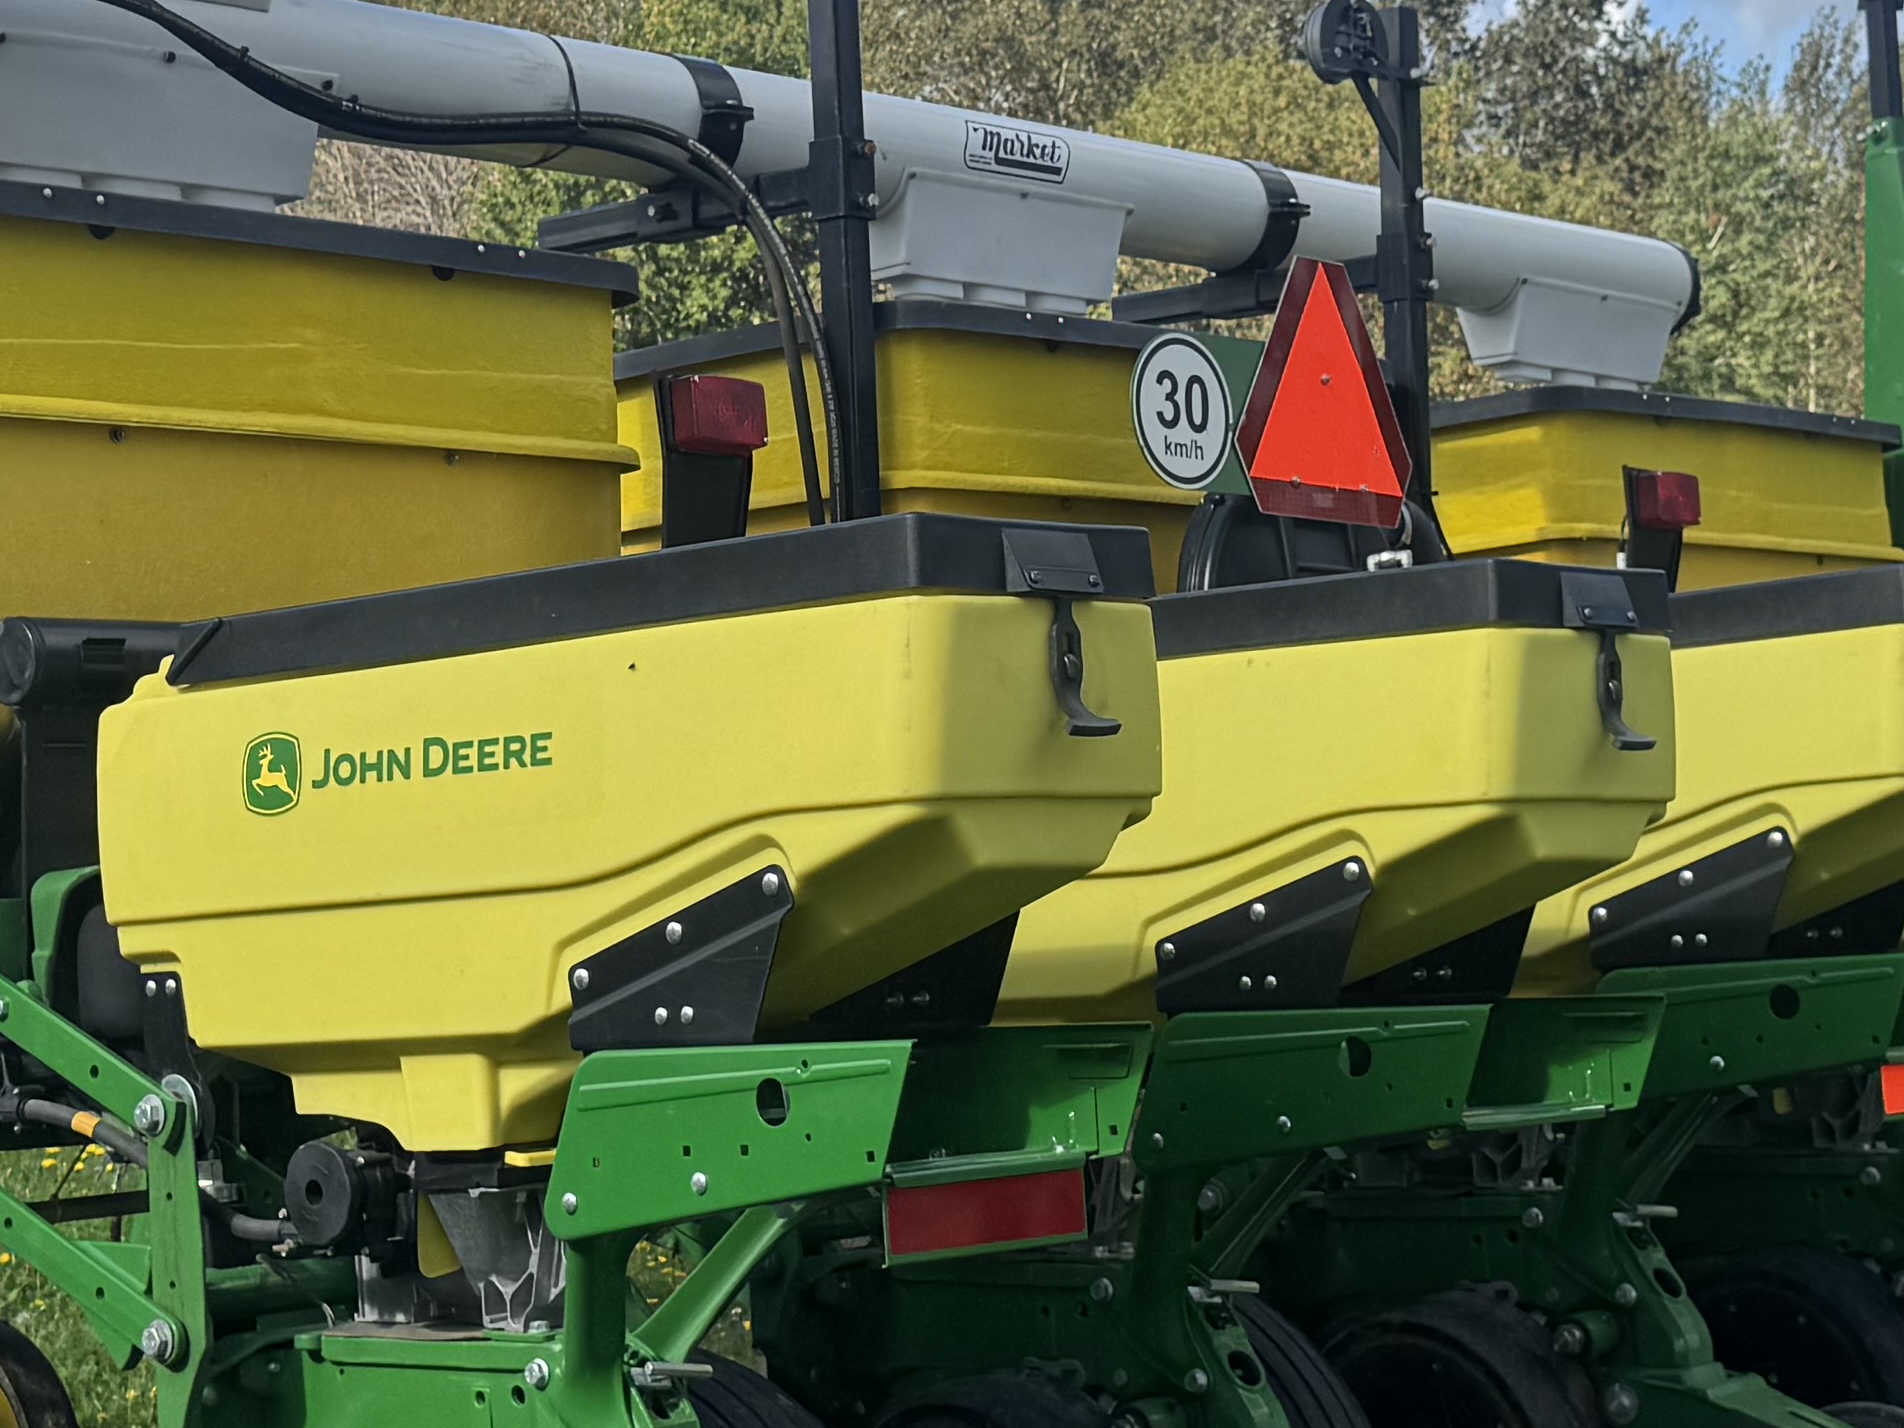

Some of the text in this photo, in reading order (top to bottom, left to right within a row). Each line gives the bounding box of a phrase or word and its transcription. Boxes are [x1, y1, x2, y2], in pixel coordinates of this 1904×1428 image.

[972, 125, 1062, 165] Market
[1156, 369, 1210, 434] 30
[1164, 434, 1204, 461] km/h
[311, 731, 553, 789] JOHN DEERE
